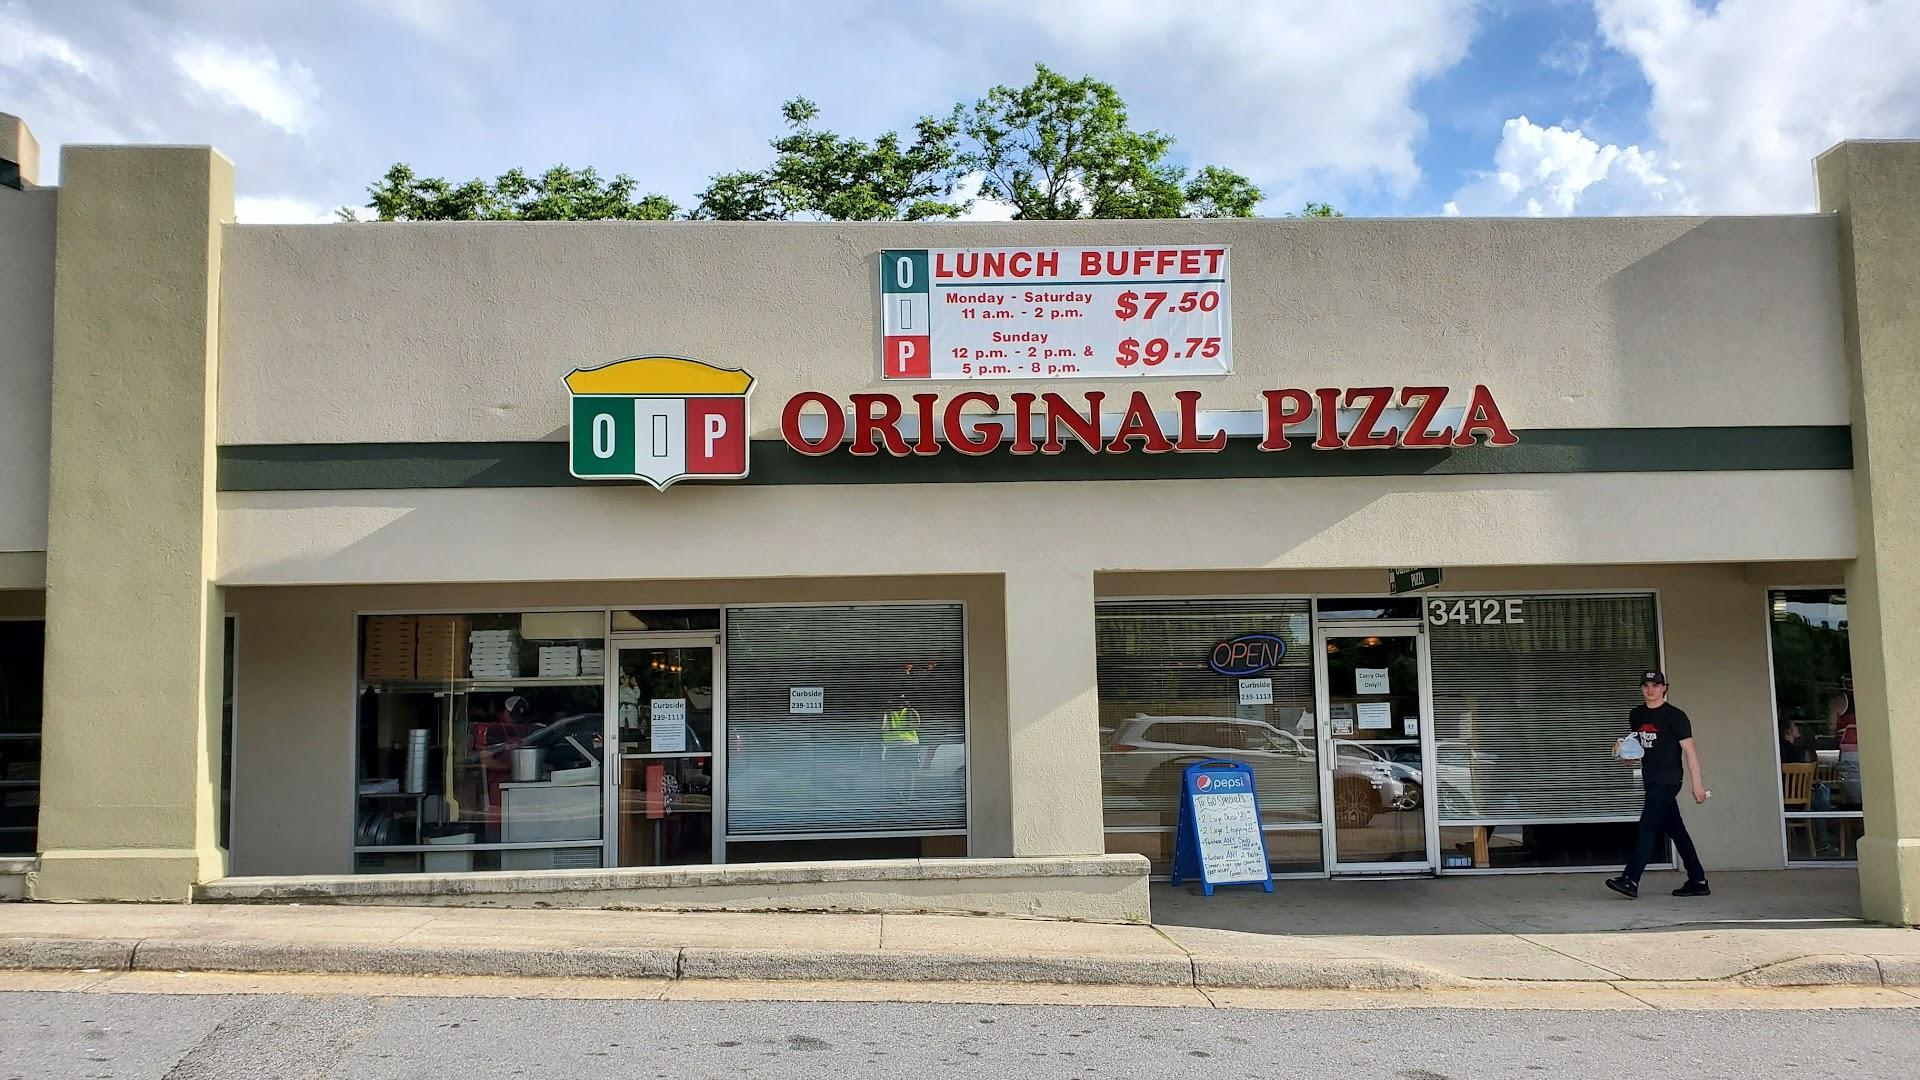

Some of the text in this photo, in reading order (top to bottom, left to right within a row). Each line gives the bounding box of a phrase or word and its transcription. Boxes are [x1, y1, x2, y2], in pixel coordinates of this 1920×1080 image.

[935, 249, 1226, 278] LUNCH BUFFET
[946, 292, 1005, 305] Monday
[1024, 291, 1093, 304] Saturday
[1114, 289, 1220, 322] $7.50
[961, 308, 976, 319] 11
[982, 310, 1014, 319] a.m.
[1034, 307, 1044, 318] 2
[1050, 309, 1083, 320] p.m.
[992, 331, 1048, 344] Sunday
[951, 347, 968, 358] 12
[975, 349, 1008, 360] p.m.
[1027, 346, 1037, 357] 2
[1044, 348, 1076, 359] p.m.
[1083, 345, 1094, 357] &
[1115, 336, 1222, 368] $9.75
[962, 363, 972, 374] 5
[978, 364, 1011, 375] p.m.
[1031, 362, 1041, 373] 8
[1048, 364, 1080, 374] p.m.
[779, 384, 1520, 457] ORIGINAL PIZZA
[1428, 599, 1525, 626] 3412E
[1213, 642, 1279, 667] OPEN
[652, 713, 684, 721] 239-1113
[1214, 777, 1244, 790] pepsi
[1225, 849, 1238, 860] ANY
